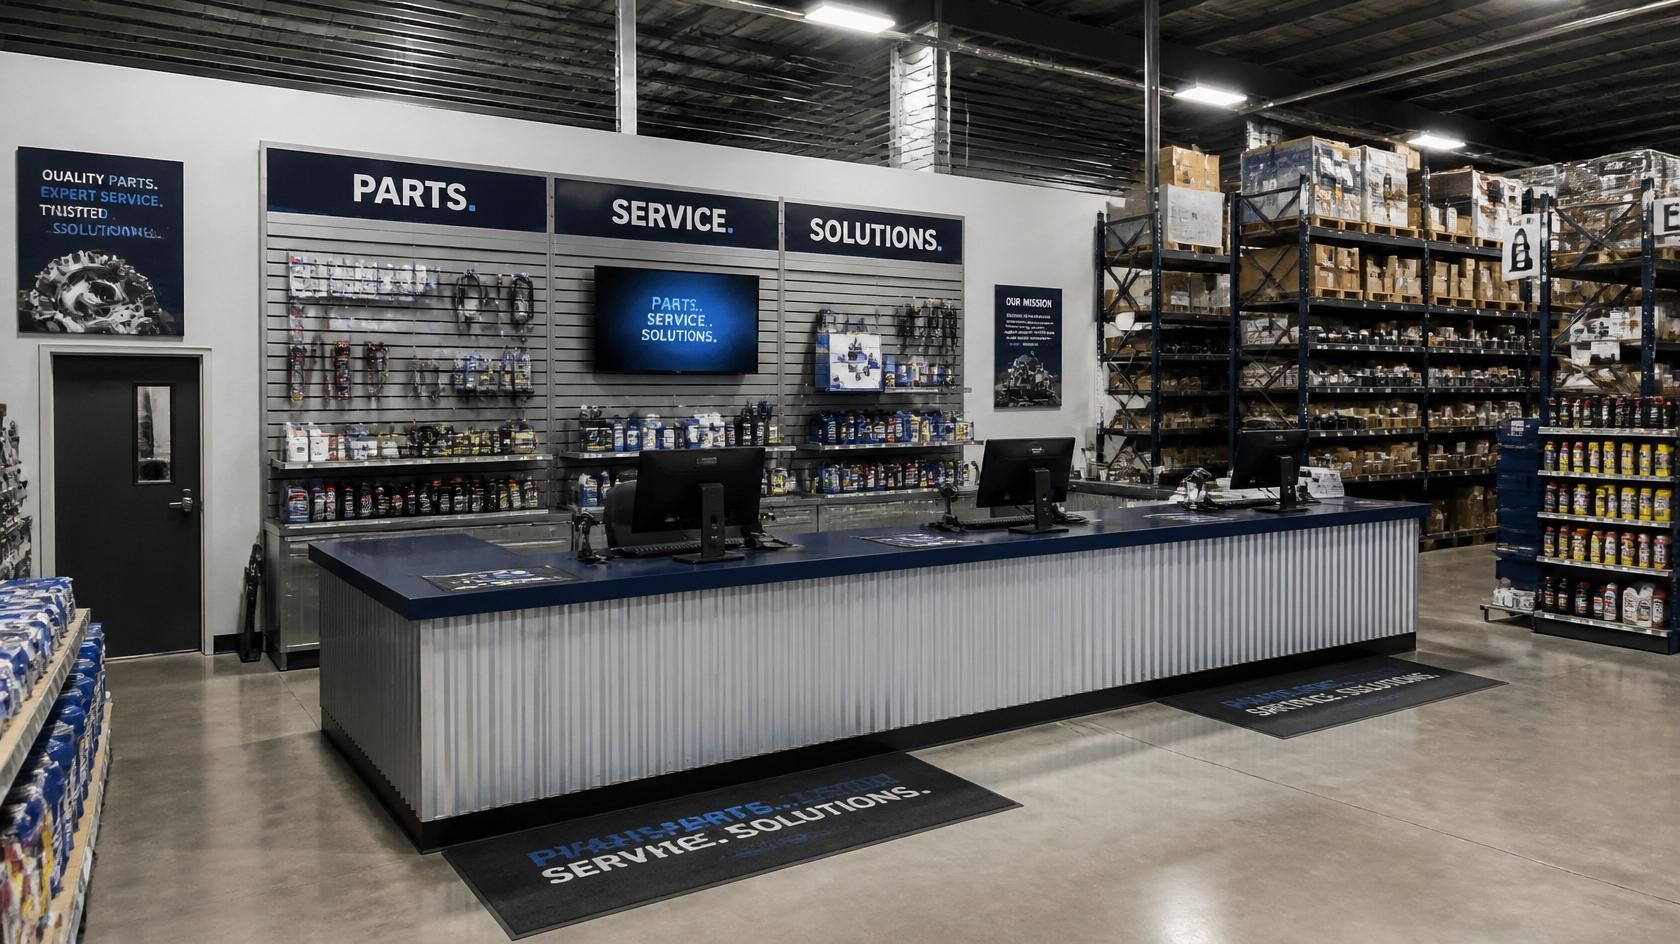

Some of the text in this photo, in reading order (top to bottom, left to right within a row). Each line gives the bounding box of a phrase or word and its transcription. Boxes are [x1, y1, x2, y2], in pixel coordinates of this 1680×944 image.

[108, 175, 159, 190] PARTS.
[353, 173, 477, 212] PARTS.
[40, 186, 164, 208] EXPERT SERVICE.
[611, 198, 734, 235] SERVICE.
[809, 217, 943, 252] SOLUTIONS.
[1006, 297, 1053, 308] OUR MISSION
[641, 328, 718, 343] SOLUTIONS.
